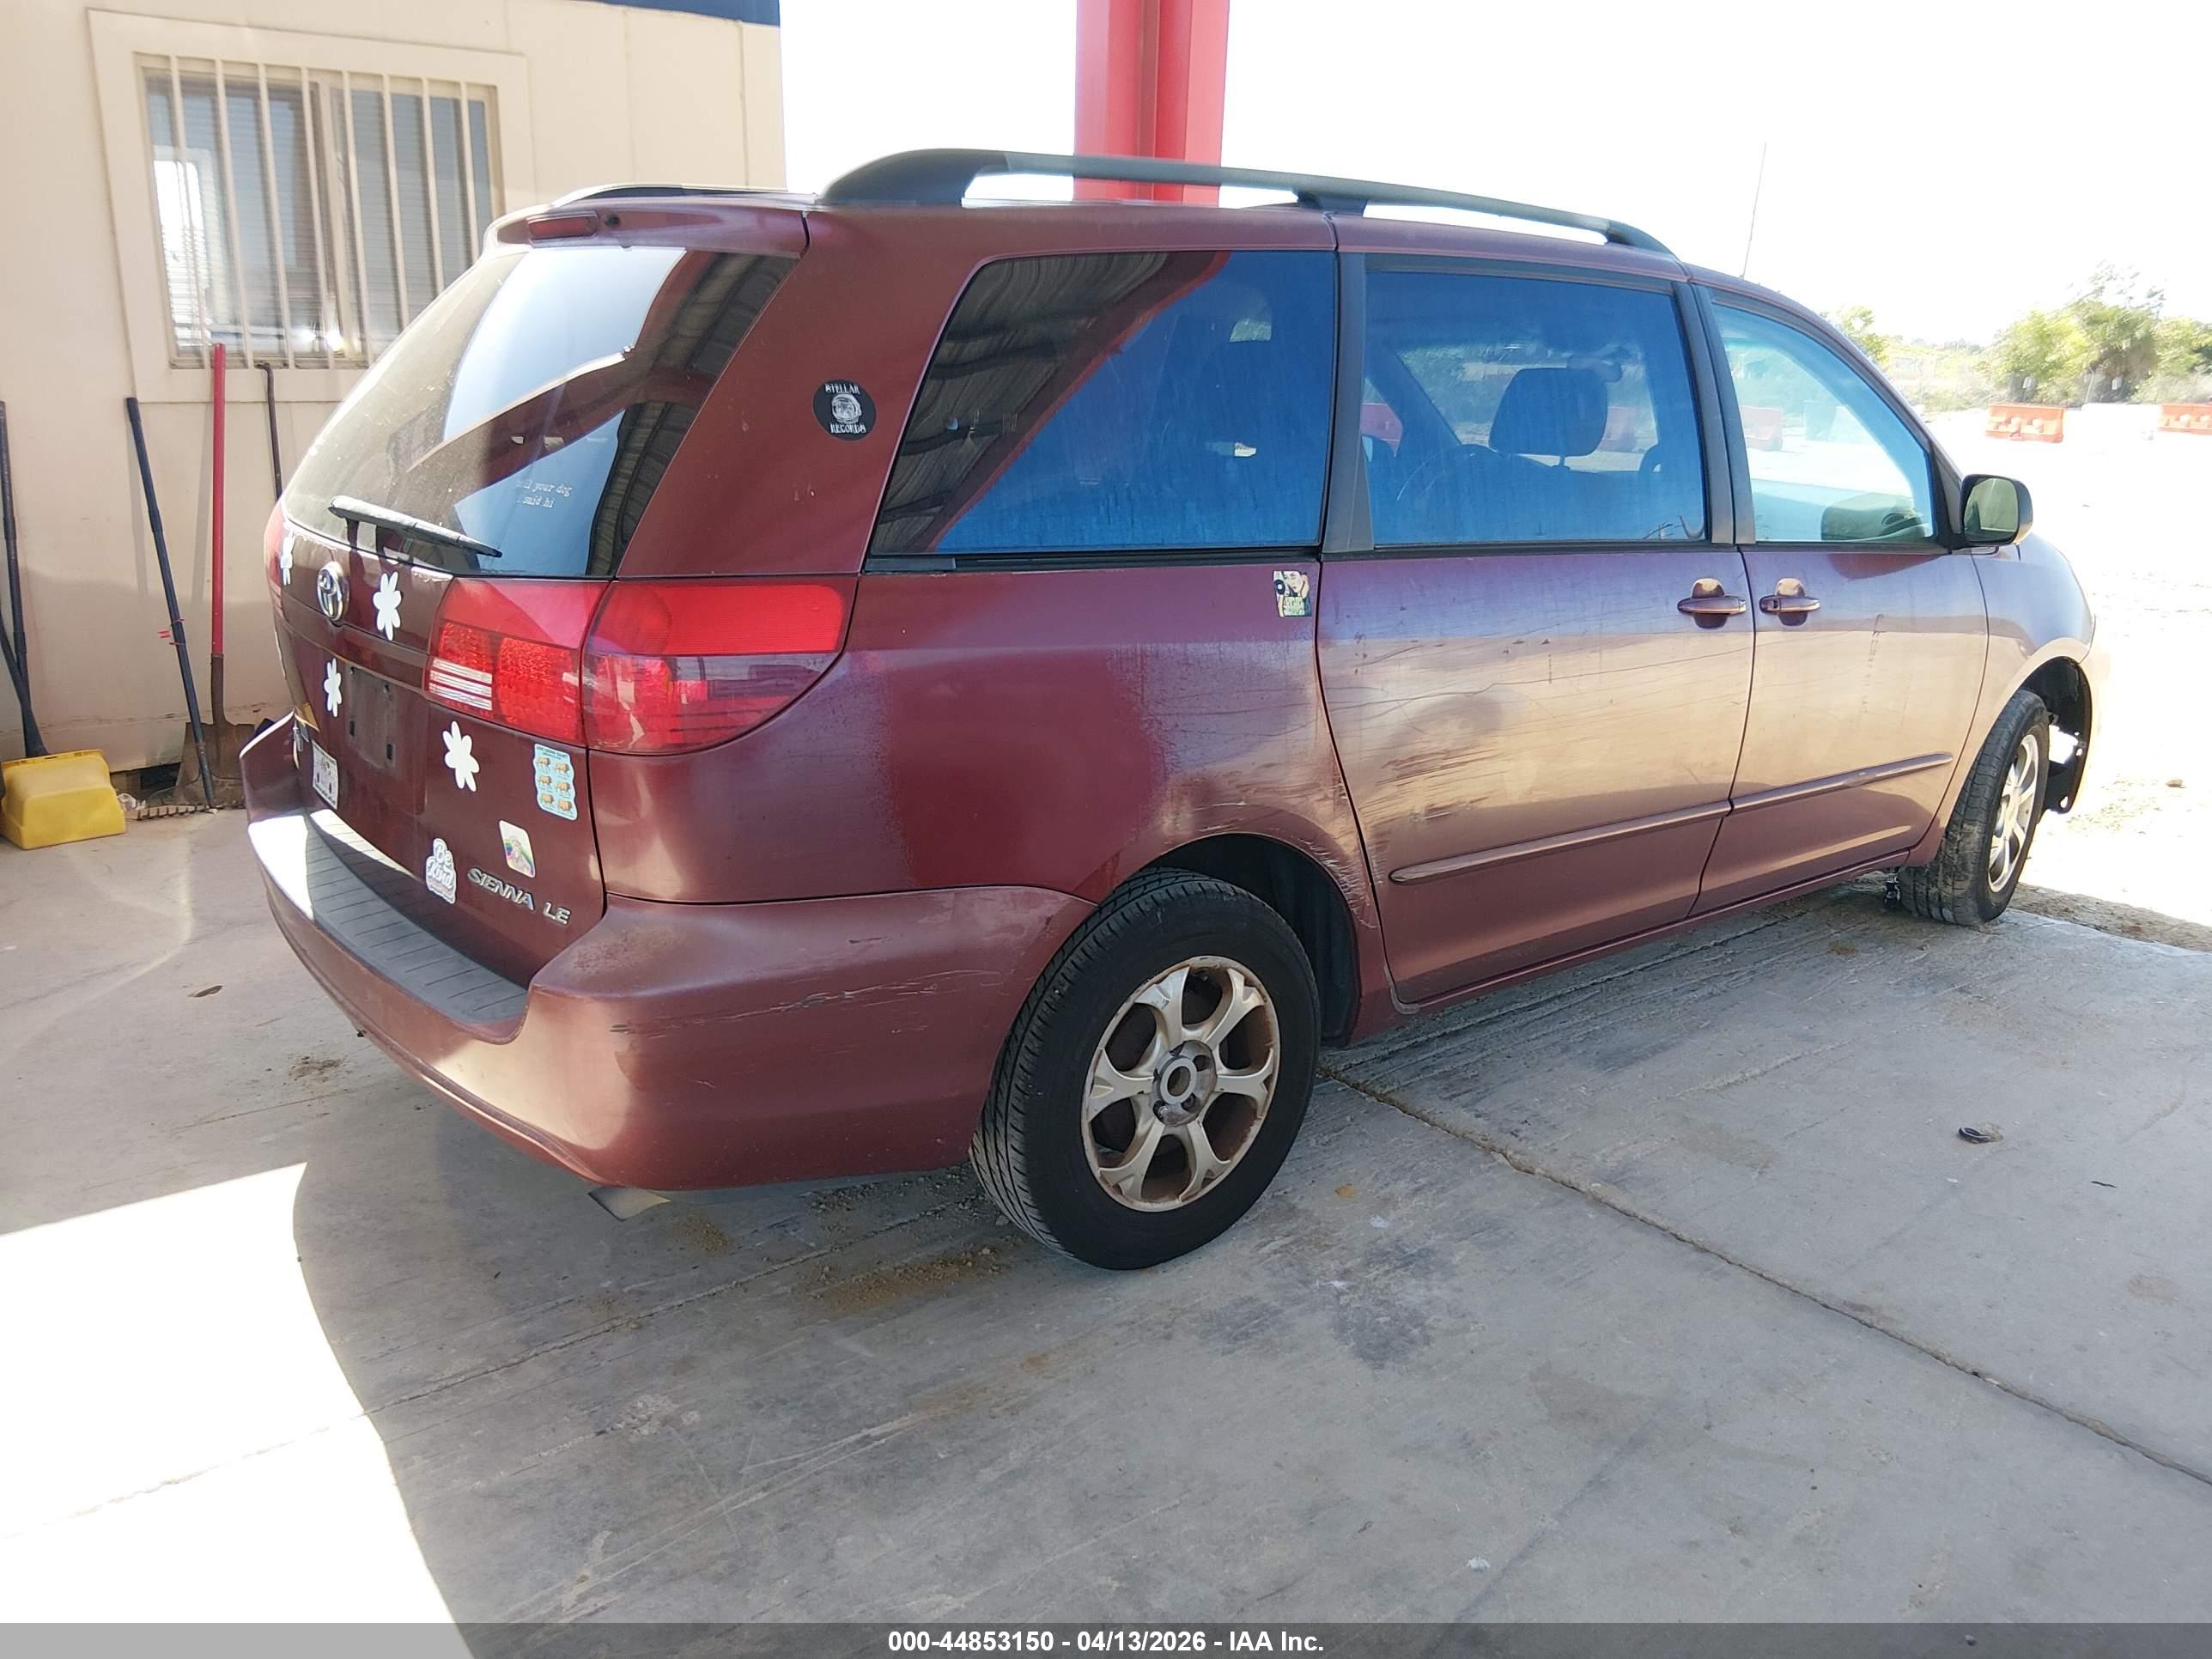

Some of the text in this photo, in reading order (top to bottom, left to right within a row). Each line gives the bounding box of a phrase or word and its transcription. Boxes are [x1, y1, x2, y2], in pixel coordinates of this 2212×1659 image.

[830, 422, 866, 434] RECORDS
[532, 483, 555, 493] your
[556, 483, 573, 497] dog
[522, 495, 543, 506] said
[543, 497, 556, 508] hi
[467, 867, 535, 911] SIENNA
[543, 902, 571, 925] LE
